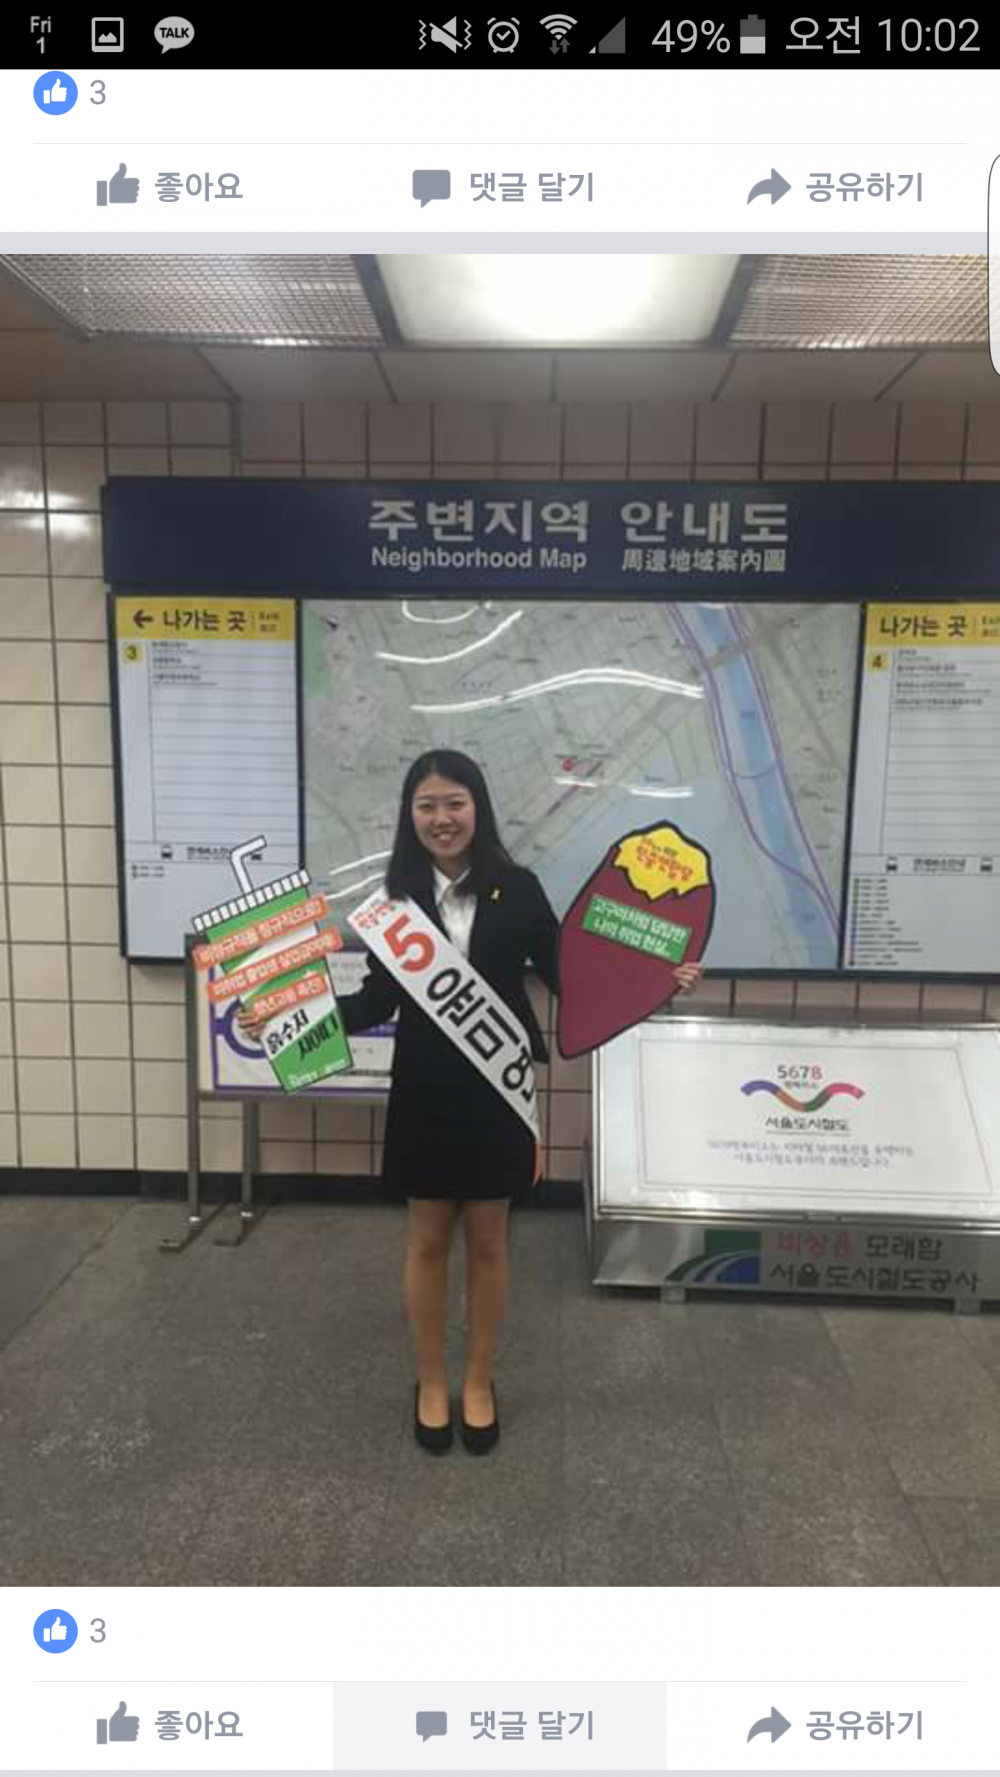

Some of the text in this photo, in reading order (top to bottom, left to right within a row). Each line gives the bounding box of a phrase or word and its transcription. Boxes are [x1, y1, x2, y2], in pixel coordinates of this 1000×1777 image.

[369, 500, 788, 544] 주변지역 안내도
[371, 547, 588, 573] Neighborhood Map
[163, 610, 246, 632] 나가는 곳
[880, 615, 966, 638] 나가는 곳
[126, 646, 138, 661] 3
[872, 654, 882, 669] 4
[383, 913, 436, 974] 5
[266, 1009, 309, 1055] 흙수저
[777, 1065, 823, 1081] 5678
[765, 1117, 849, 1132] 서울도시철도
[778, 1230, 943, 1262] 비상용 모래함
[770, 1261, 980, 1294] 서울도시철도공사
